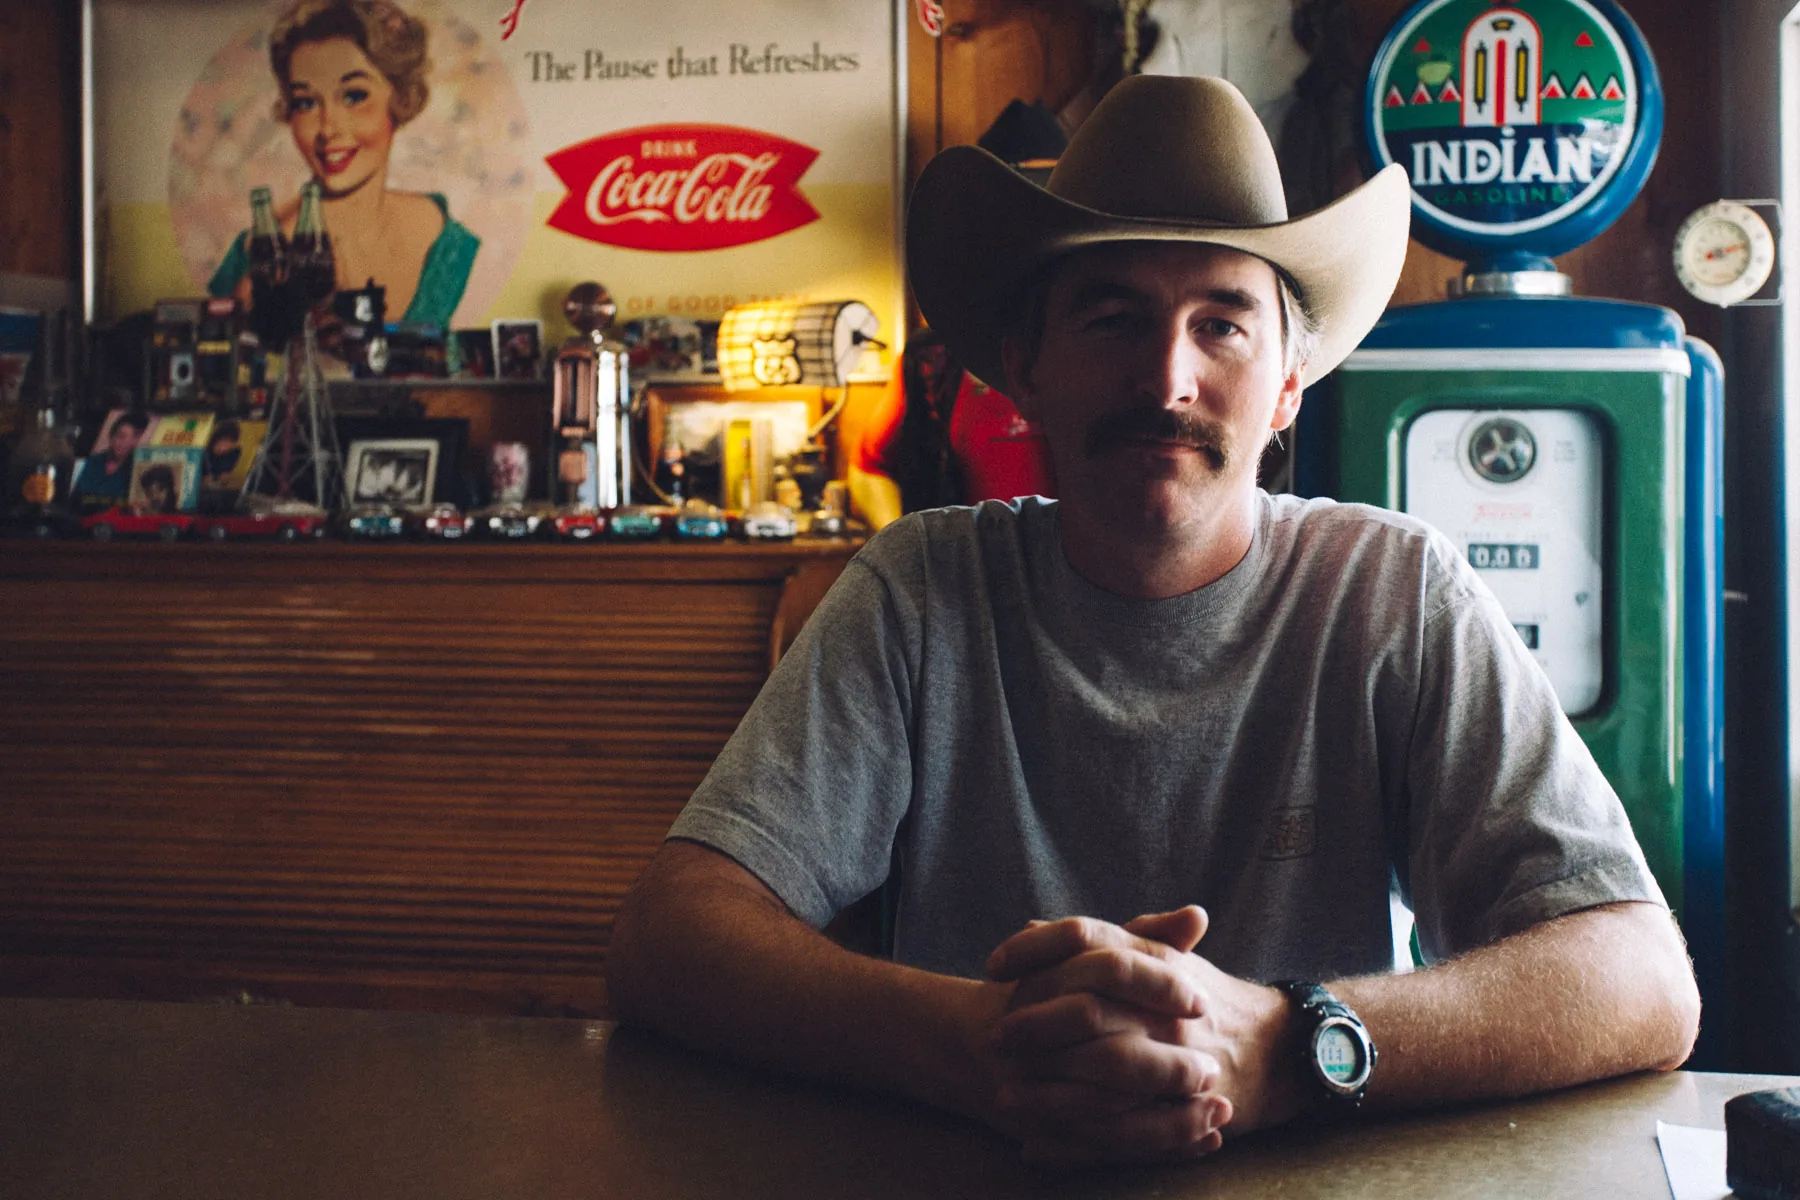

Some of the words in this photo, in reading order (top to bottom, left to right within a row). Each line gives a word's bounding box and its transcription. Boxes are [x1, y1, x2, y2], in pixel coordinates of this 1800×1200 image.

[524, 51, 577, 82] The
[583, 49, 658, 80] Pause
[666, 46, 717, 79] that
[729, 41, 860, 75] Refreshes
[641, 140, 697, 158] DRINK
[1411, 127, 1594, 186] INDIAN
[585, 152, 782, 225] Coca-Cola
[1435, 185, 1572, 206] GASOLINE
